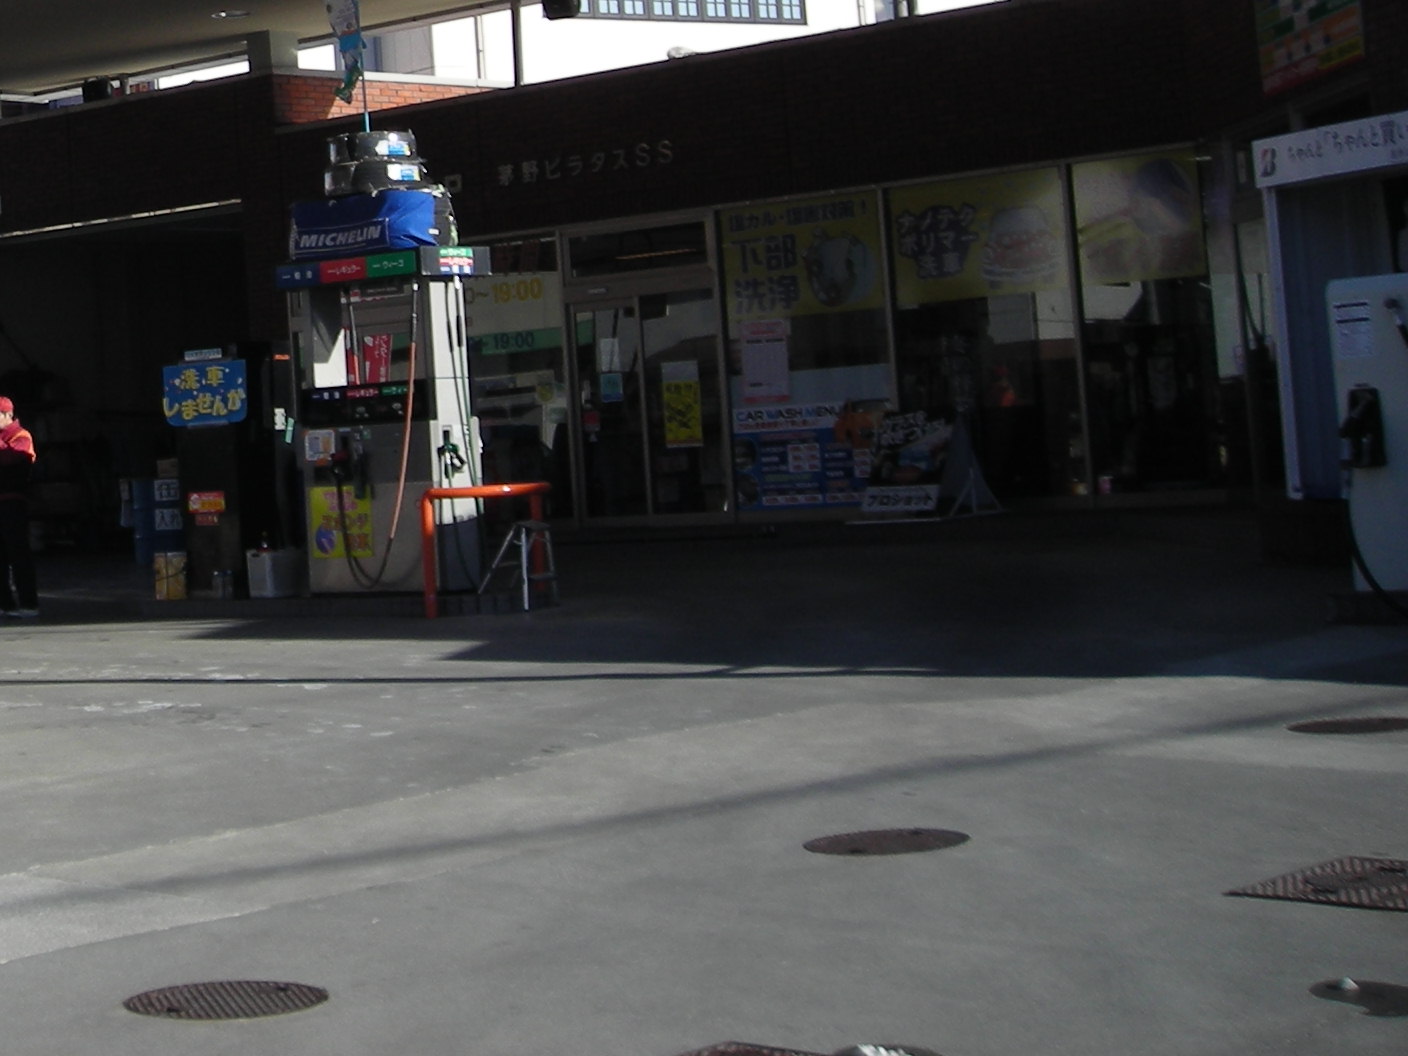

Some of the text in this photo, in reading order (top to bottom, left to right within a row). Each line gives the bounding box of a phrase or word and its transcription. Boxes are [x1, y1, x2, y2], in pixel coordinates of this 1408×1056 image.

[300, 225, 381, 248] MICHELIN
[180, 366, 225, 390] 洗車
[736, 410, 764, 422] CAR
